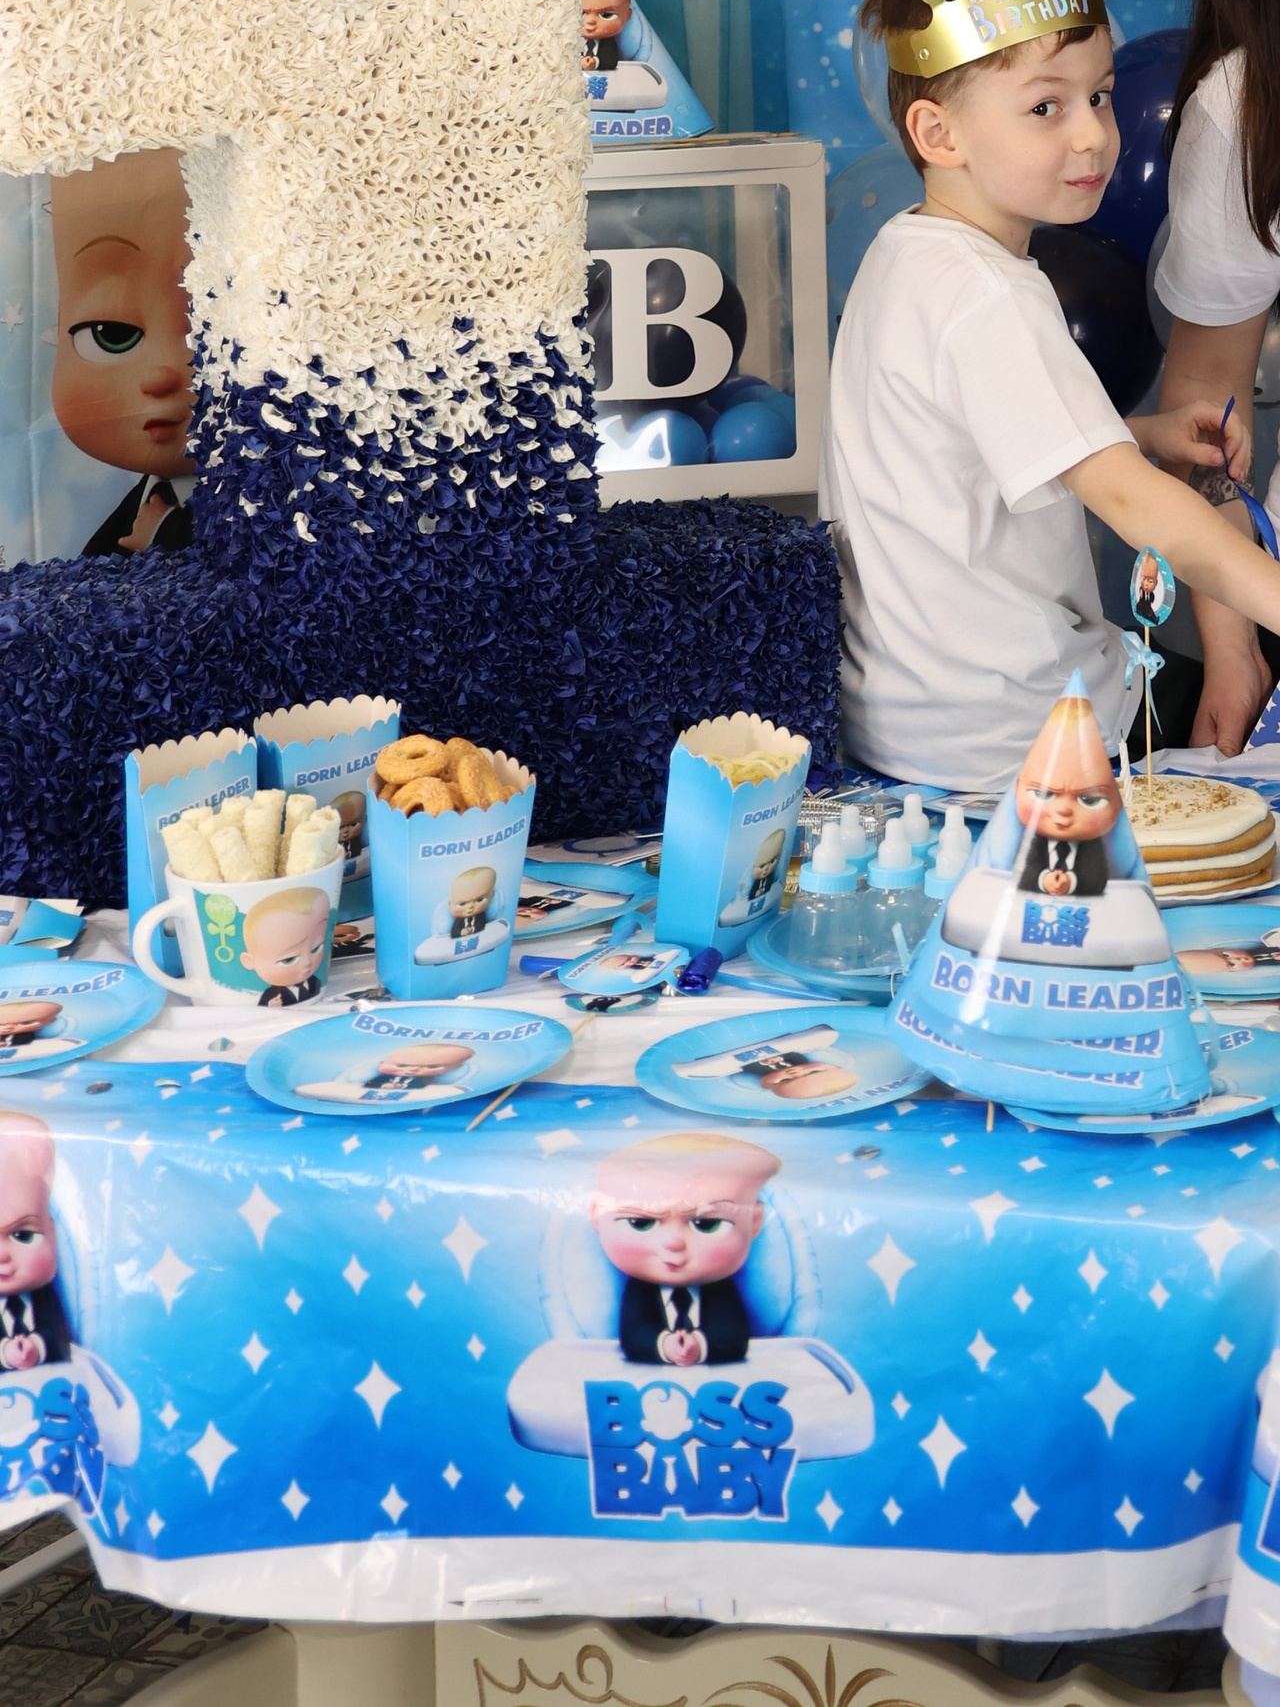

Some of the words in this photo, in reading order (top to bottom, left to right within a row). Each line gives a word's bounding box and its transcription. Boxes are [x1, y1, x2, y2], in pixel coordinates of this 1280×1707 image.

[590, 116, 672, 136] EADER
[591, 247, 734, 402] B
[296, 765, 342, 787] BORN
[346, 752, 379, 774] LEAD
[743, 805, 779, 826] BORN
[421, 841, 471, 858] BORN
[478, 818, 526, 849] LEADER
[19, 970, 123, 998] LEADER
[934, 954, 1032, 1005] BORN
[1048, 975, 1184, 1010] LEADER
[353, 1014, 435, 1038] BORN
[443, 1021, 542, 1041] LEADER
[584, 1380, 794, 1449] BOSS
[591, 1443, 797, 1519] BABY
